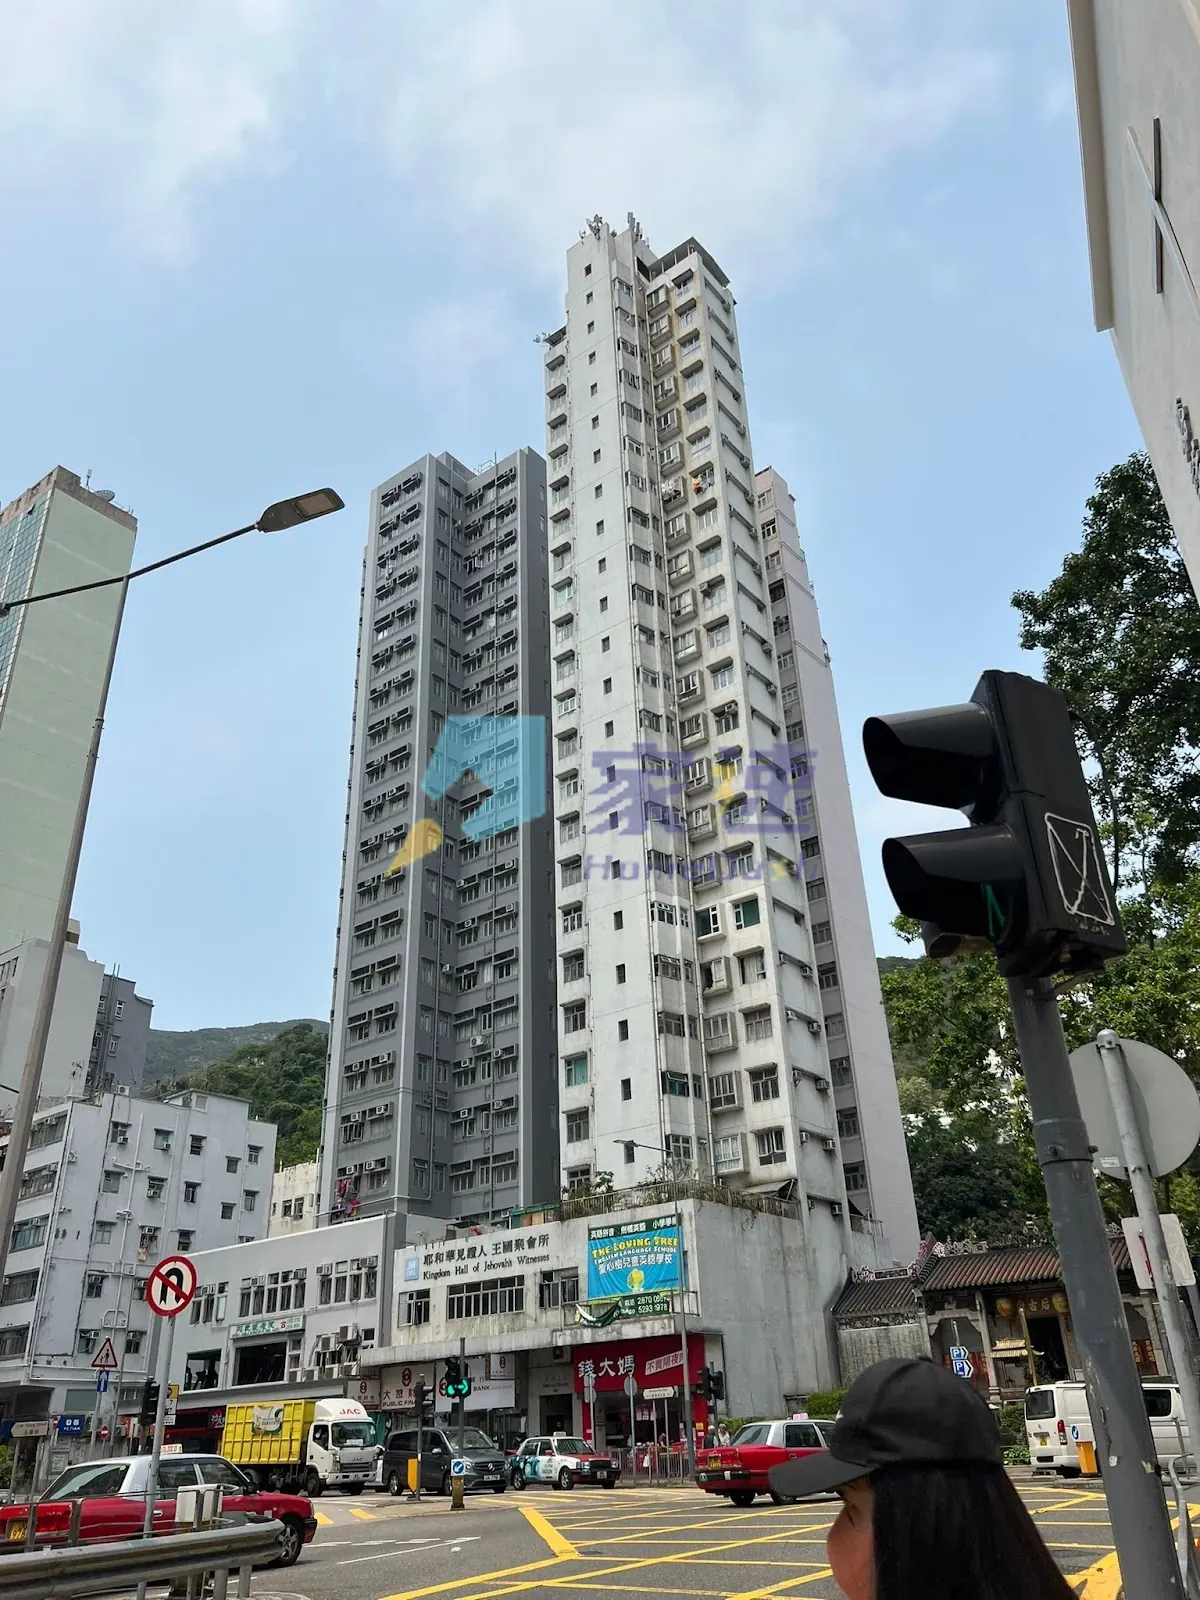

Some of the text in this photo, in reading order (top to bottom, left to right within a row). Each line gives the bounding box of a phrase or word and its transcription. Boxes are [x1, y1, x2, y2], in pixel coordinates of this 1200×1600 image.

[591, 1236, 679, 1258] THE LOVING TREE
[594, 1251, 619, 1265] ENGLISH
[619, 1246, 651, 1256] LANGUAGE
[423, 1270, 451, 1280] Kingdom
[455, 1265, 469, 1275] Hall
[517, 1253, 550, 1265] Witnesses
[577, 1355, 636, 1378] 錢大媽
